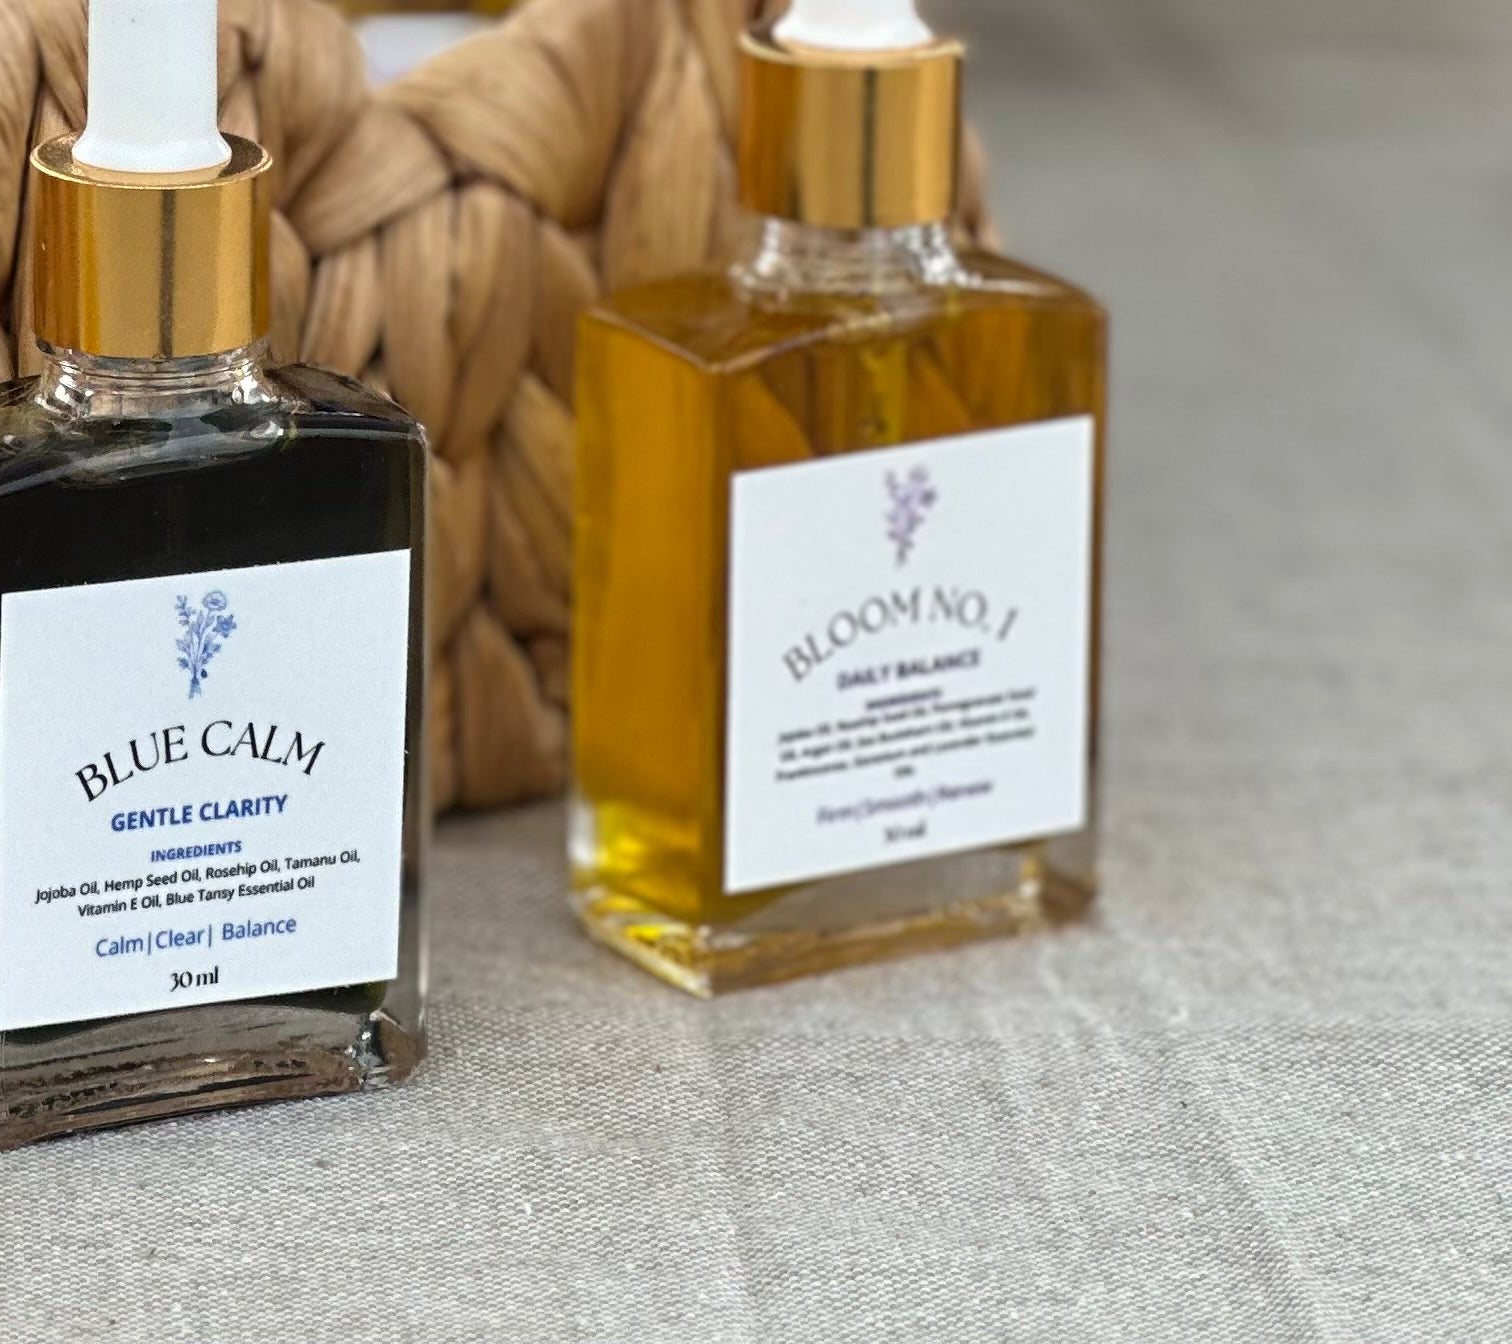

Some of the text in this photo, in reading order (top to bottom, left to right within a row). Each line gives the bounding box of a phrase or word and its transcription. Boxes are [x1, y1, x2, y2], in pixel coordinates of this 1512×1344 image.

[782, 587, 920, 683] BLOOM
[838, 649, 980, 690] DAILY BALANCE
[75, 720, 326, 801] BLUE CALM
[111, 794, 288, 832] GENTLE CLARITY
[150, 840, 242, 862] INGREDIENTS
[34, 849, 360, 904] Jojoba Oil, Hemp Seed Oil, Rosehip Oil, Tamanu Oil,
[78, 899, 128, 918] Vitamin
[130, 897, 139, 911] E
[166, 891, 194, 907] Blue
[198, 888, 235, 904] Tansy
[238, 878, 294, 897] Essential
[297, 876, 315, 891] Oil
[222, 917, 297, 941] Balance
[170, 965, 219, 993] 30 ml
